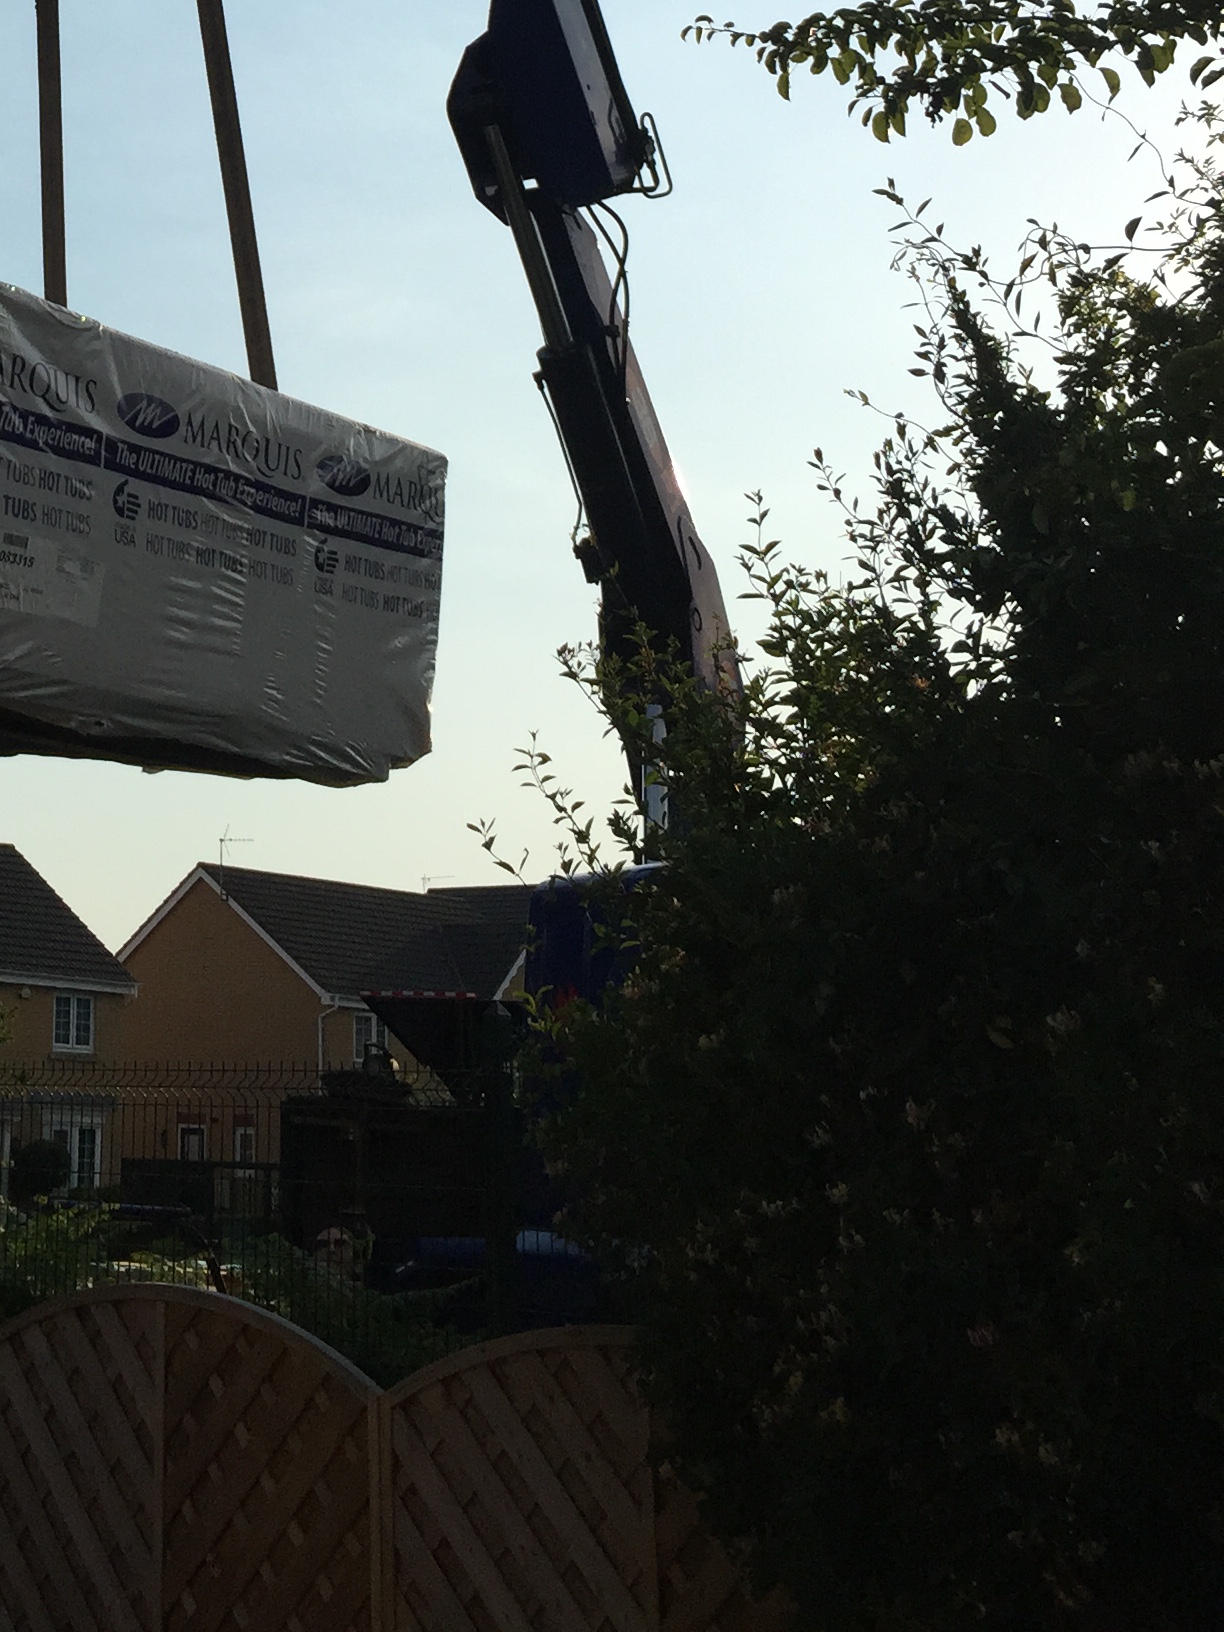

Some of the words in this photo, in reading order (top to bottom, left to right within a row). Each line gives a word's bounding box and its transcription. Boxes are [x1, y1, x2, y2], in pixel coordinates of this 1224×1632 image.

[26, 416, 96, 455] Experience!
[183, 412, 303, 480] MARQUIS
[4, 460, 36, 487] TUBS
[38, 468, 62, 495] HOT
[63, 474, 94, 501] TUBS
[115, 442, 137, 466] The
[138, 449, 193, 485] ULTIMATE
[193, 468, 216, 490] Hot
[216, 473, 235, 496] Tub
[236, 479, 302, 518] Experience!
[2, 493, 38, 523] TUBS
[41, 503, 64, 530] HOT
[65, 510, 92, 535] TUBS
[147, 498, 170, 524] HOT
[171, 504, 199, 530] TUBS
[247, 527, 268, 549] HOT
[269, 532, 297, 558] TUBS
[114, 528, 137, 547] USA
[146, 532, 168, 555] HOT
[195, 546, 218, 567] HOT
[248, 556, 268, 578] HOT
[269, 562, 294, 587] TUBS
[344, 553, 363, 575] HOT
[363, 557, 386, 581] TUBS
[342, 582, 360, 605] HOT
[382, 593, 400, 614] HOT
